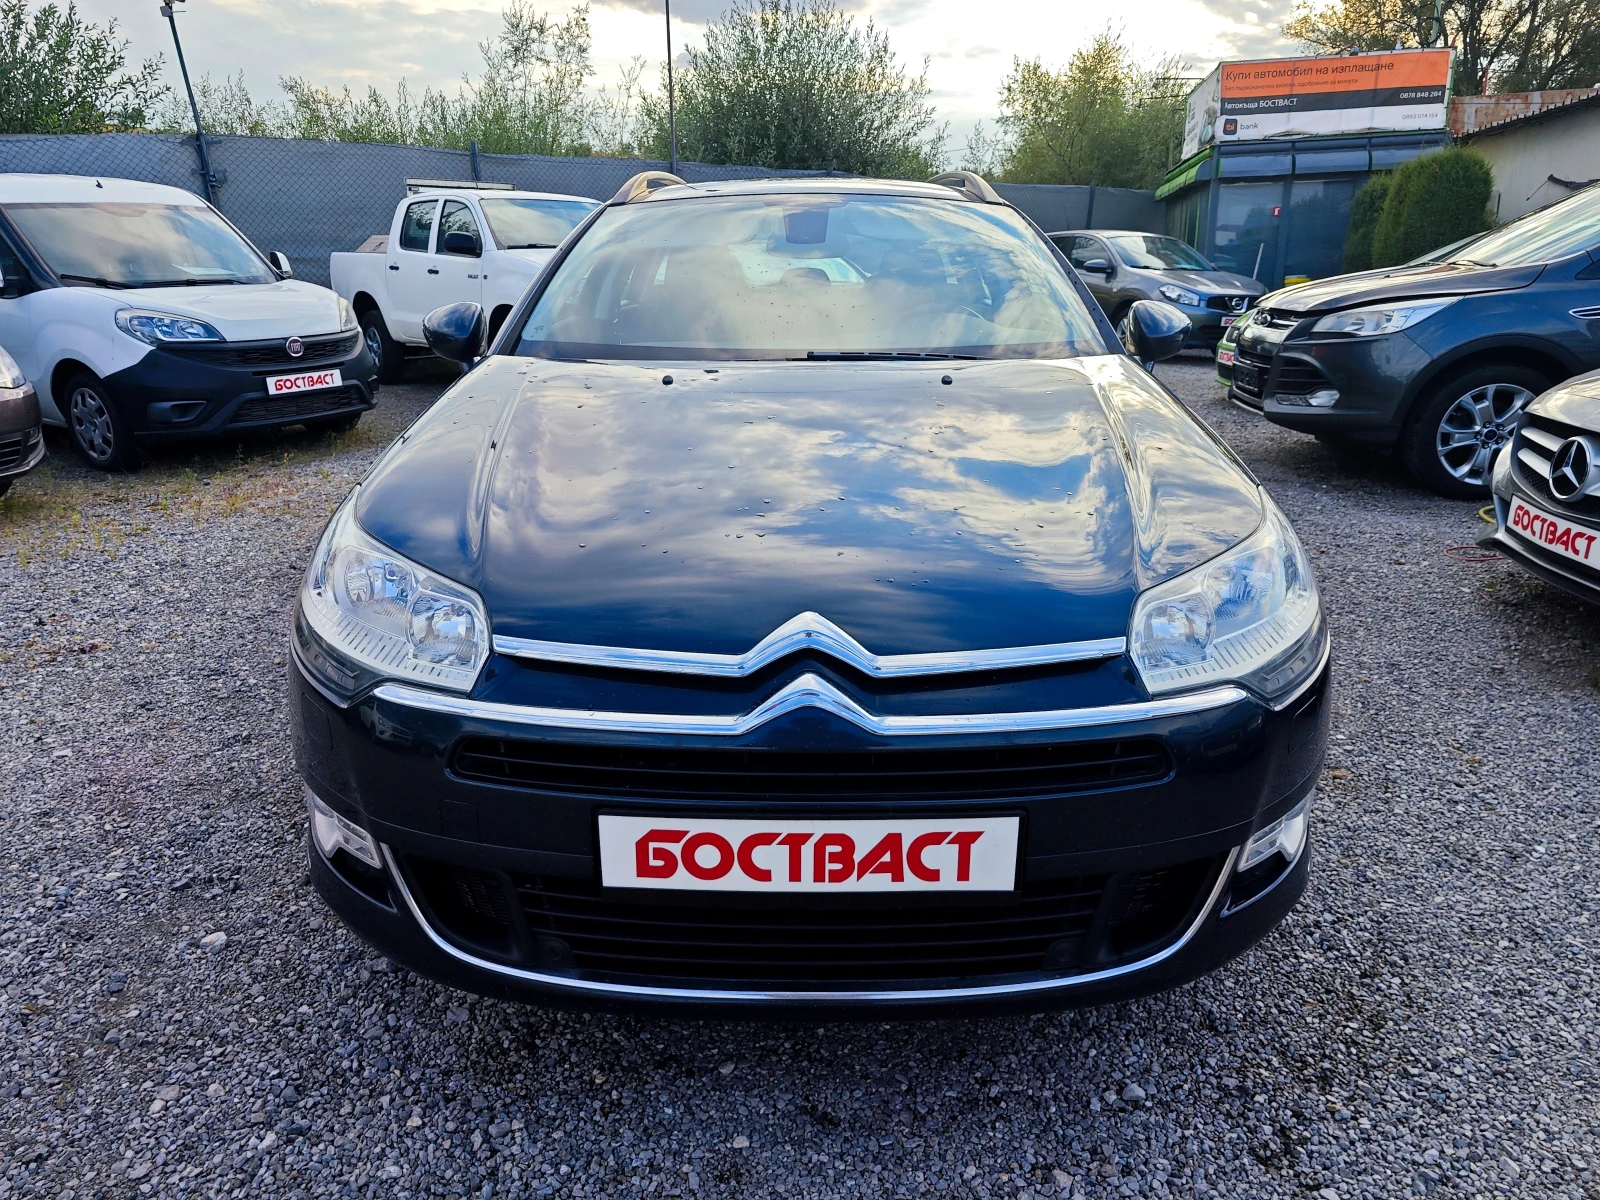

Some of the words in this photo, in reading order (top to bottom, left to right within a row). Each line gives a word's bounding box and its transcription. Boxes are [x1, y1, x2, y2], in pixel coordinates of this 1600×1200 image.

[1226, 70, 1251, 82] Купи
[1253, 66, 1313, 79] автомобил
[1315, 66, 1329, 75] на
[1331, 62, 1394, 74] изплащане
[1259, 98, 1298, 108] БОСТВАСТ
[1240, 122, 1259, 130] bank
[274, 373, 335, 392] БОСТВАСТ
[1512, 504, 1598, 560] БОСТВАСТ
[635, 829, 985, 883] БОСТВАСТ
